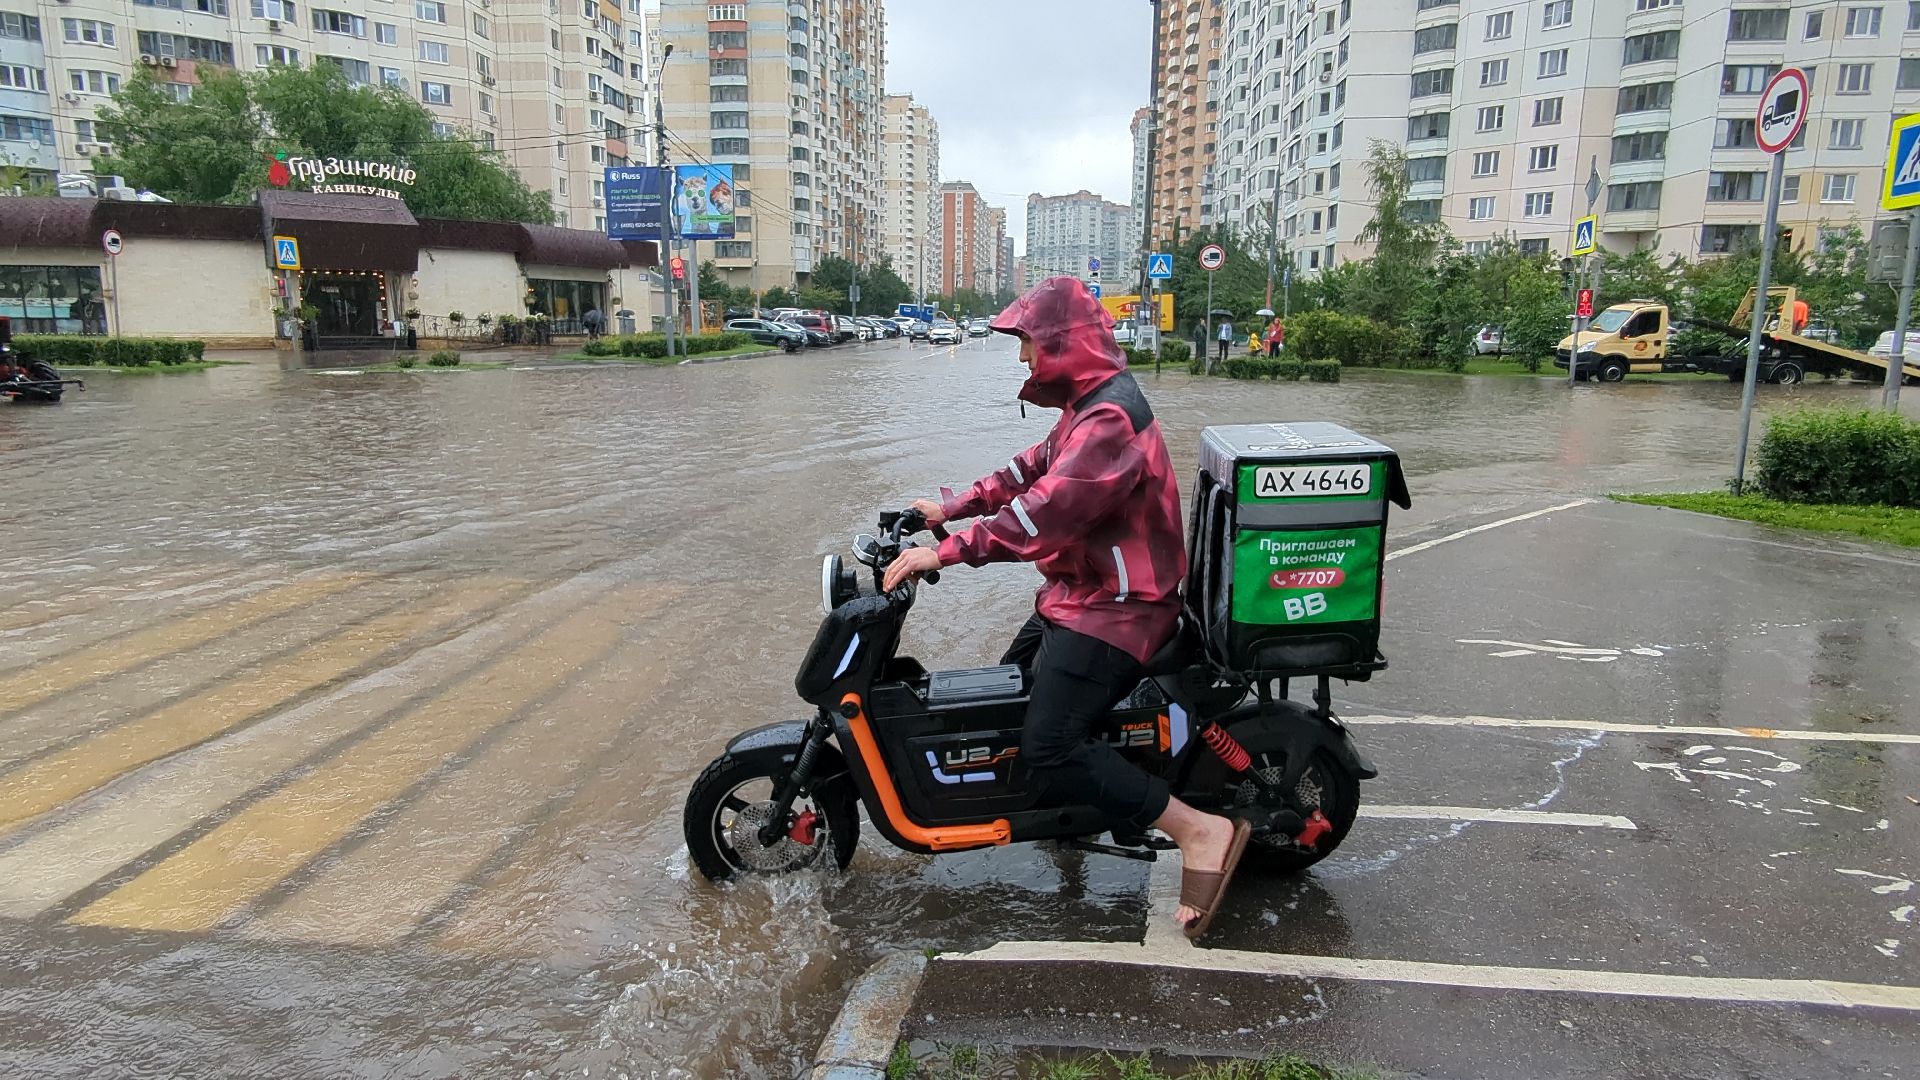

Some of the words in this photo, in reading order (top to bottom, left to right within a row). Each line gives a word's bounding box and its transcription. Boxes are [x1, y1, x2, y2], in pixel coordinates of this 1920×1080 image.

[288, 157, 416, 186] Грузинские
[621, 172, 641, 180] Russ
[312, 184, 400, 200] КАНИКУЛЫ
[1578, 303, 1593, 317] 26
[1302, 469, 1364, 491] 4646
[1259, 538, 1356, 554] Приглашаем
[1269, 555, 1279, 565] в
[1282, 551, 1346, 565] команду
[1121, 722, 1153, 731] TRUCK
[945, 746, 991, 765] U2
